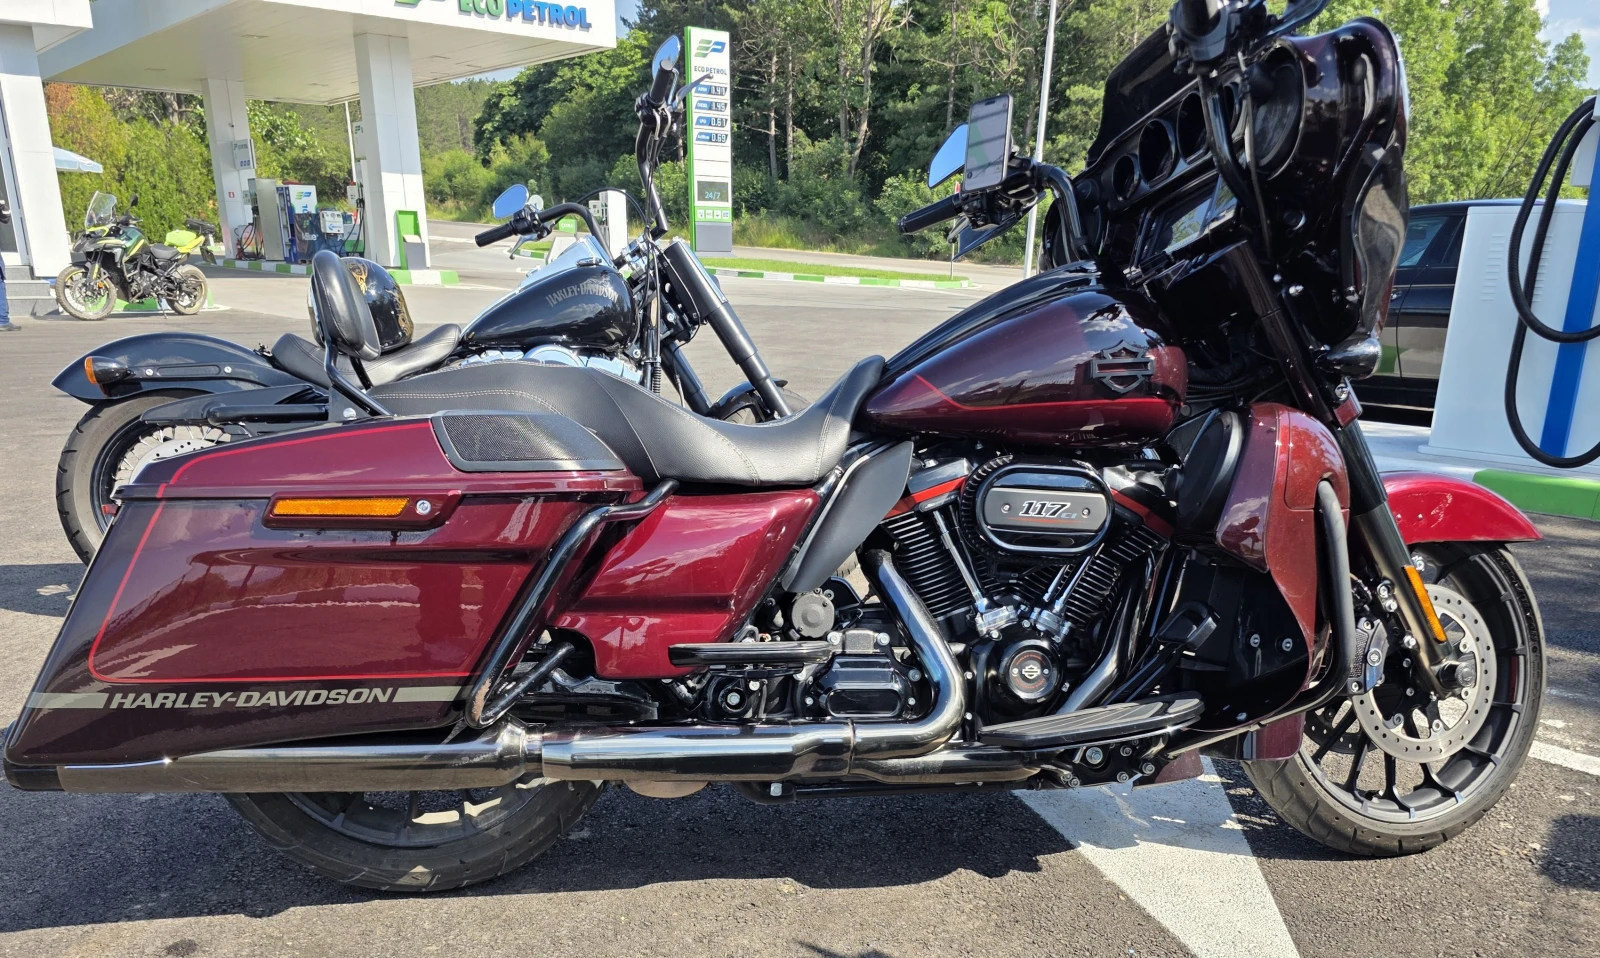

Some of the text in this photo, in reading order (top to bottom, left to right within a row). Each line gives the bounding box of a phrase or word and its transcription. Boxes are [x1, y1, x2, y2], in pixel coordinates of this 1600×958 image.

[711, 133, 726, 143] 0.69
[704, 191, 721, 200] 24/7
[109, 687, 393, 709] HARLEY-DAVIDSON
